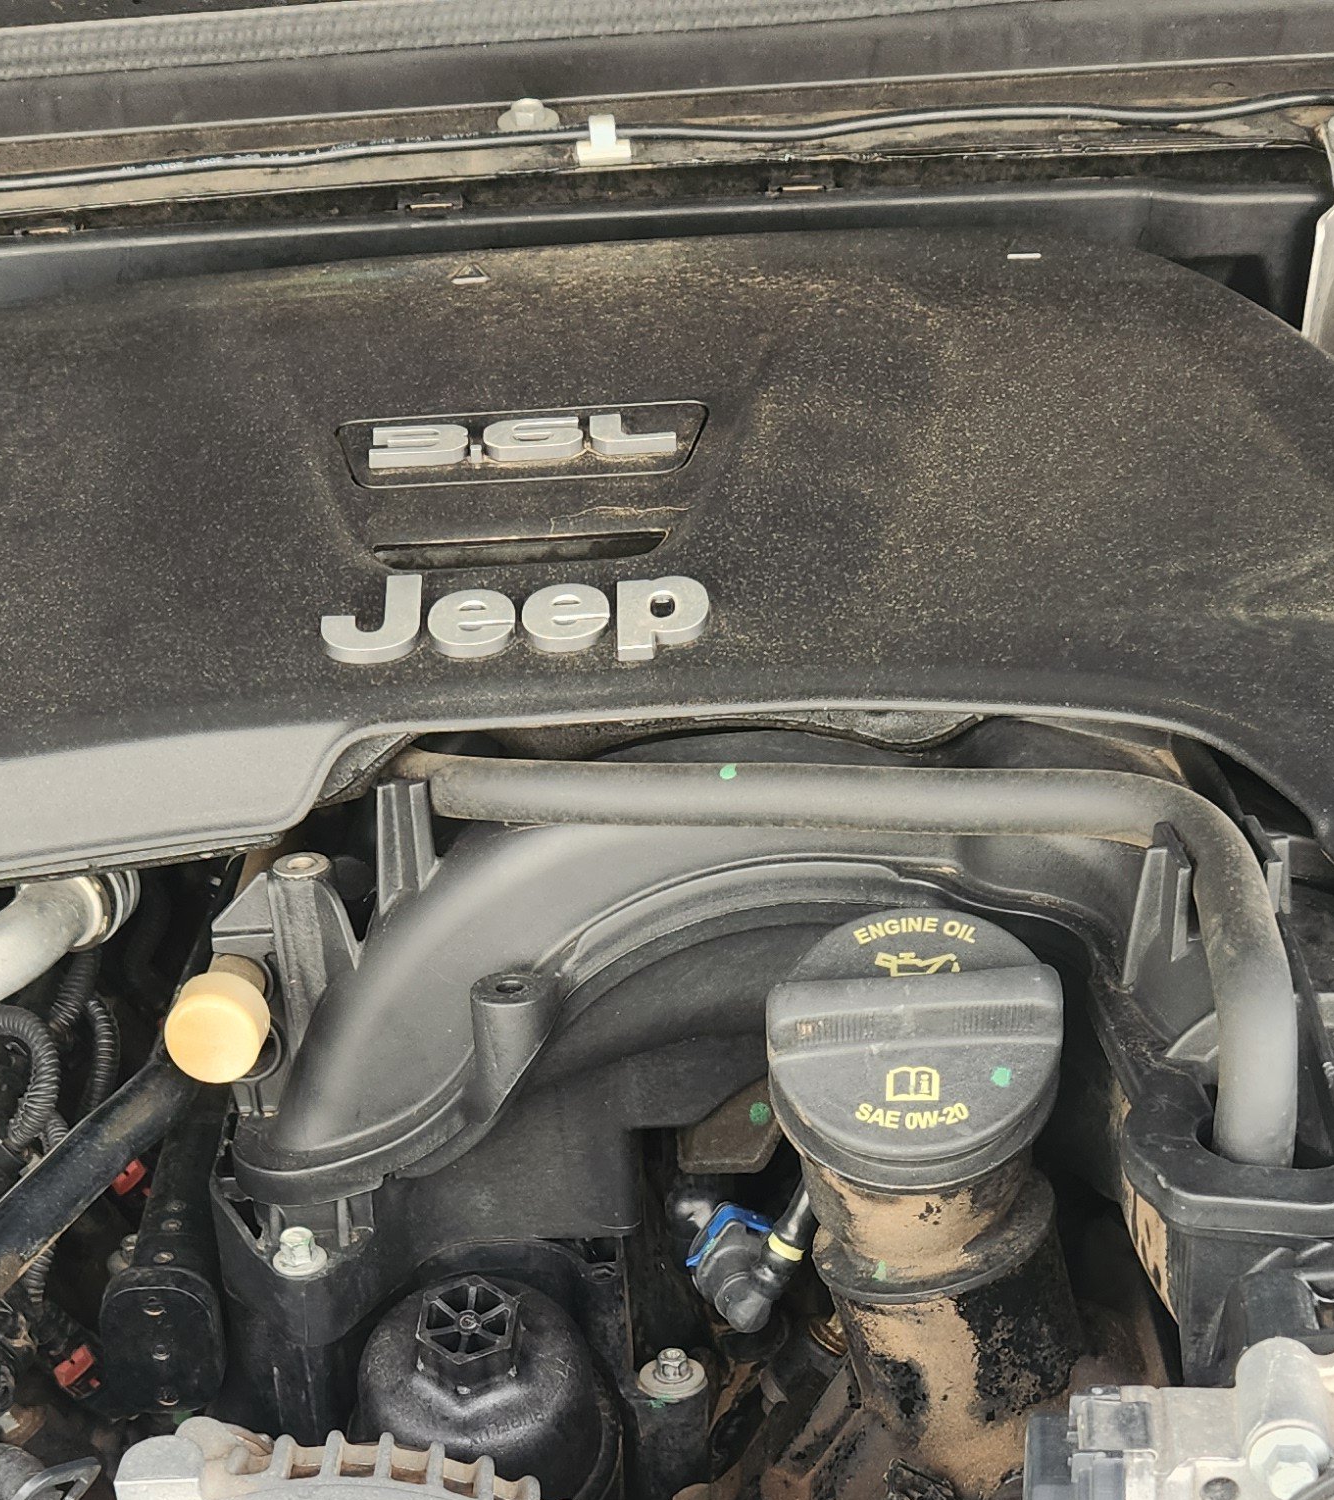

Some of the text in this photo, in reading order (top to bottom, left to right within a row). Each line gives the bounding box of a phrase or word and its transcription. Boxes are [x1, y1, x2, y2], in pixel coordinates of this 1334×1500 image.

[368, 413, 677, 469] 3.6L
[320, 573, 710, 664] Jeep
[853, 916, 977, 945] ENGINE OIL
[855, 1102, 969, 1130] SAE 0W-20
